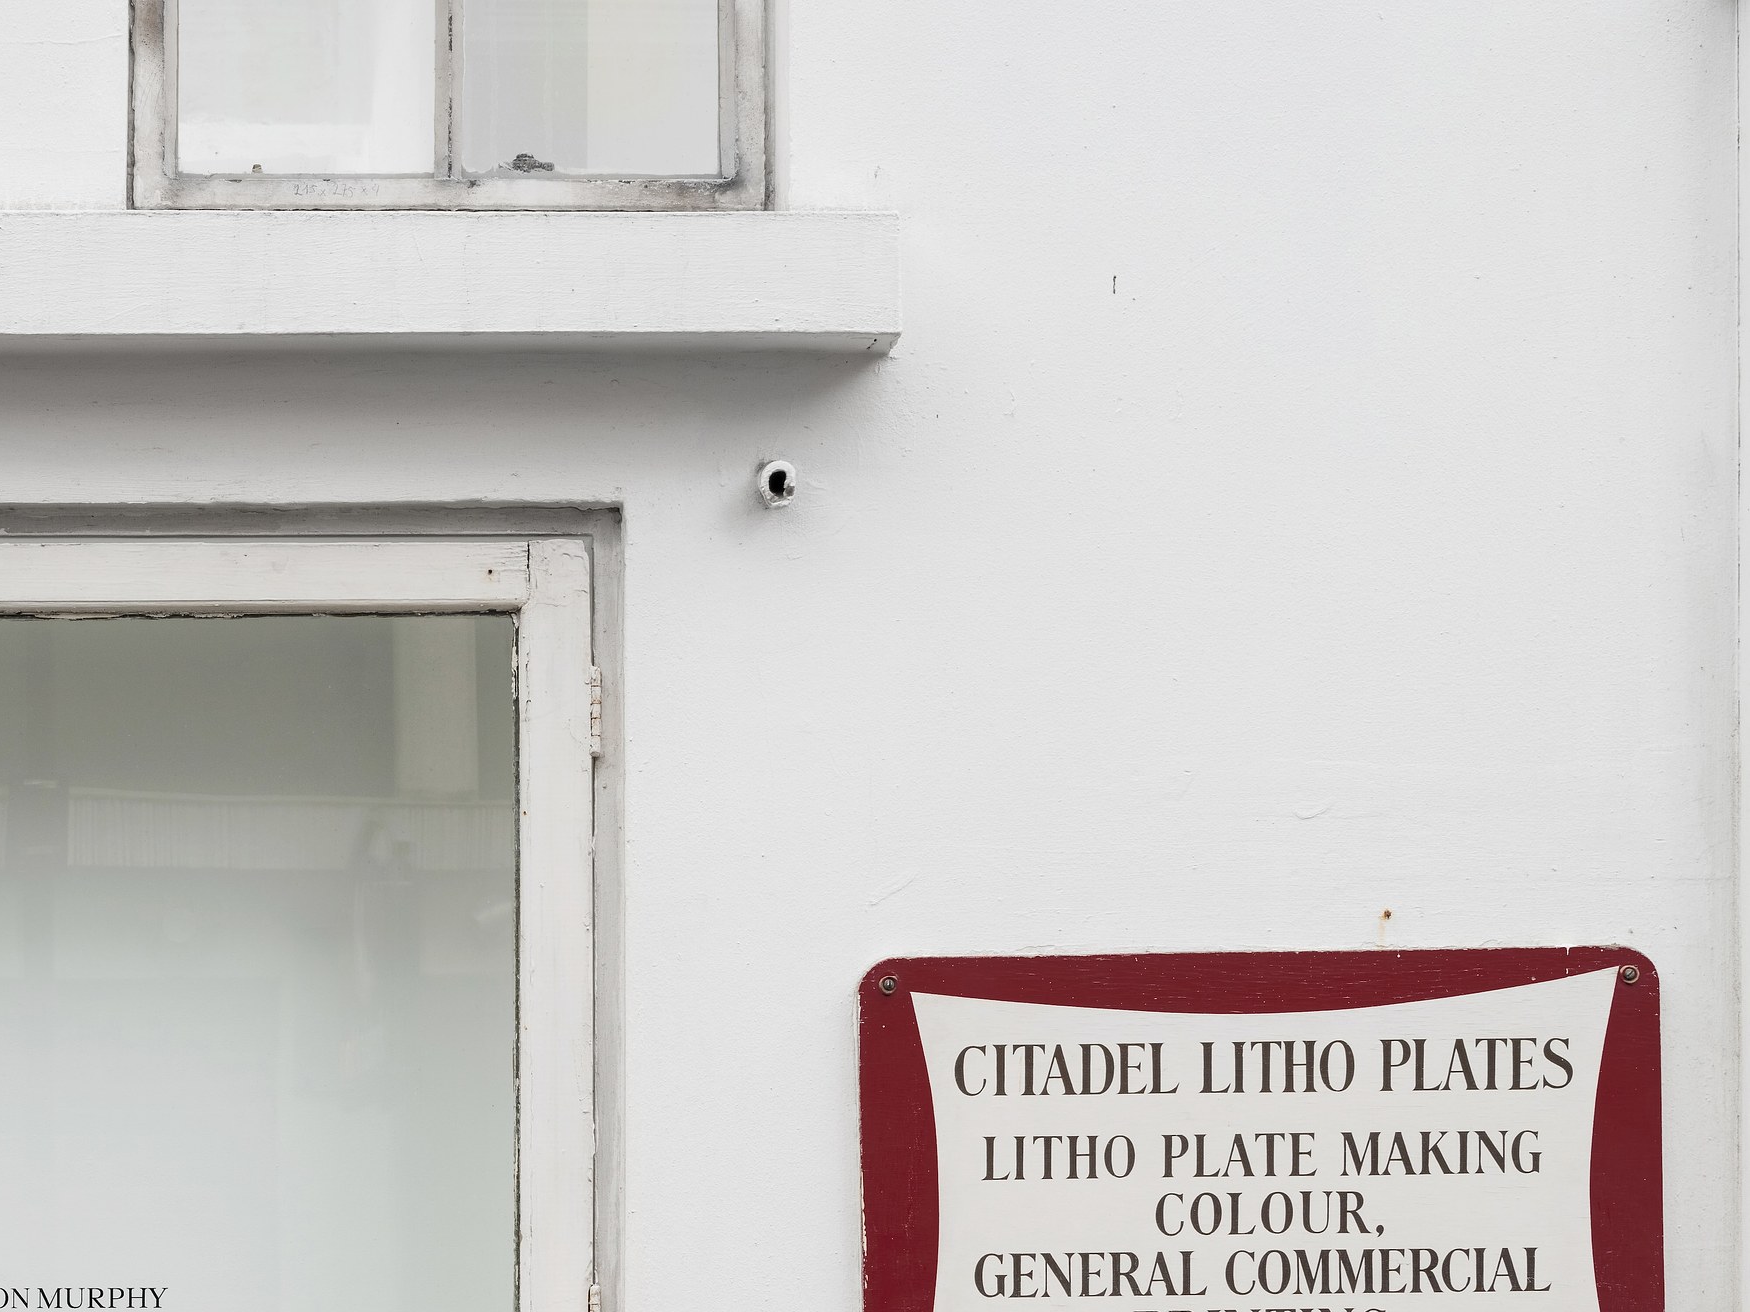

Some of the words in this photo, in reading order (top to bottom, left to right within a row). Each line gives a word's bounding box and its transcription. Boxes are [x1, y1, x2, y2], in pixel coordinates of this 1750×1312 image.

[954, 1042, 1180, 1097] CITADEL
[1199, 1039, 1355, 1094] LITHO
[1379, 1037, 1574, 1092] PLATES
[981, 1135, 1136, 1181] LITHO
[1161, 1132, 1318, 1178] PLATE
[1340, 1129, 1542, 1177] MAKING
[1155, 1190, 1385, 1238] COLOUR,
[36, 1287, 169, 1310] MURPHY
[974, 1250, 1208, 1299] GENERAL
[1225, 1247, 1552, 1296] COMMERCIAL
